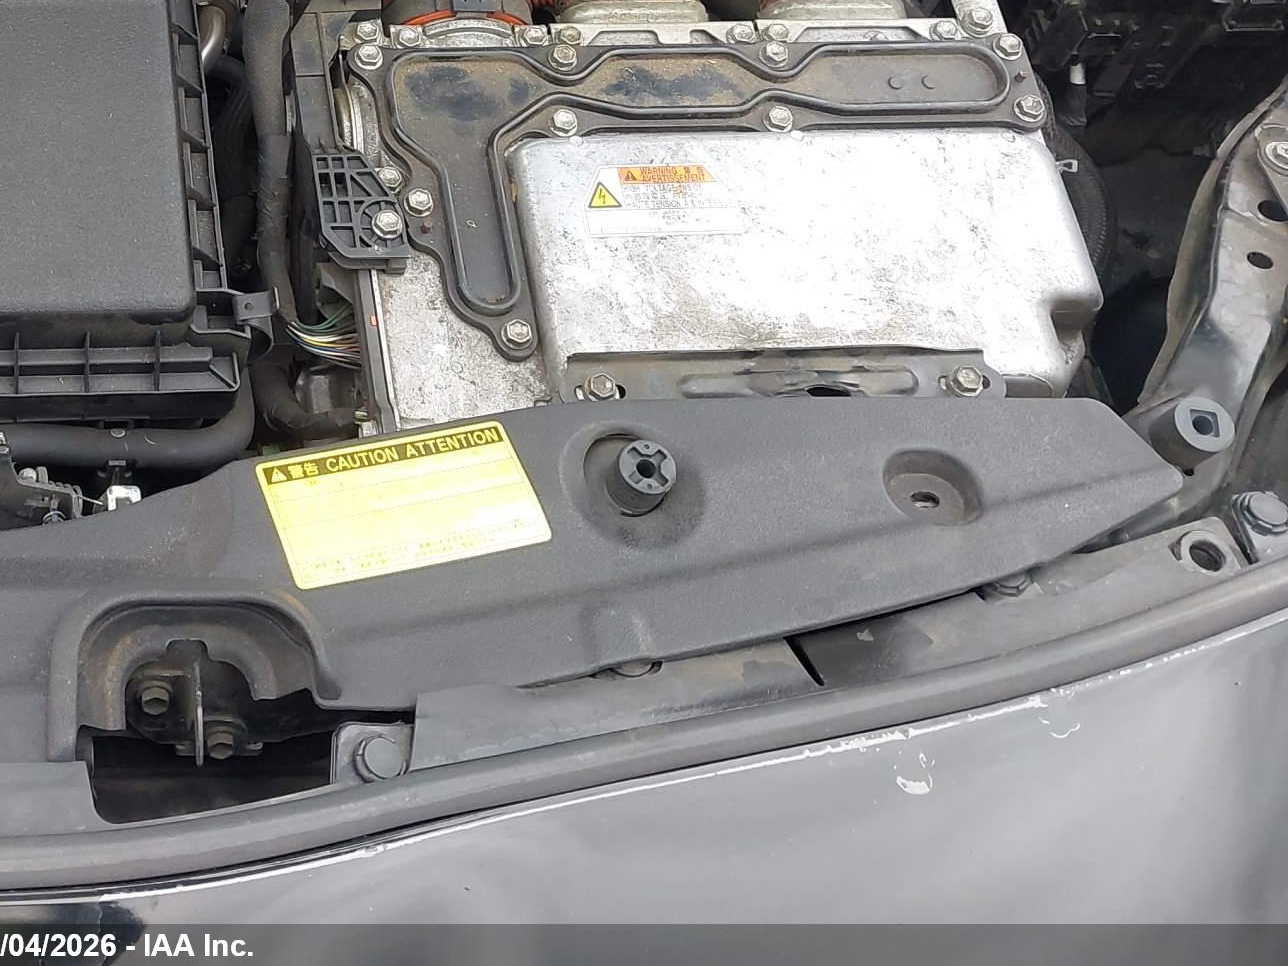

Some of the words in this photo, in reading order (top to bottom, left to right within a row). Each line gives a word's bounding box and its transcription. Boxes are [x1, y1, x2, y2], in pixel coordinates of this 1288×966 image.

[640, 166, 678, 175] WARNING
[641, 174, 705, 183] AVERTISSEMENT
[325, 446, 400, 472] CAUTION
[406, 428, 500, 459] ATTENTION
